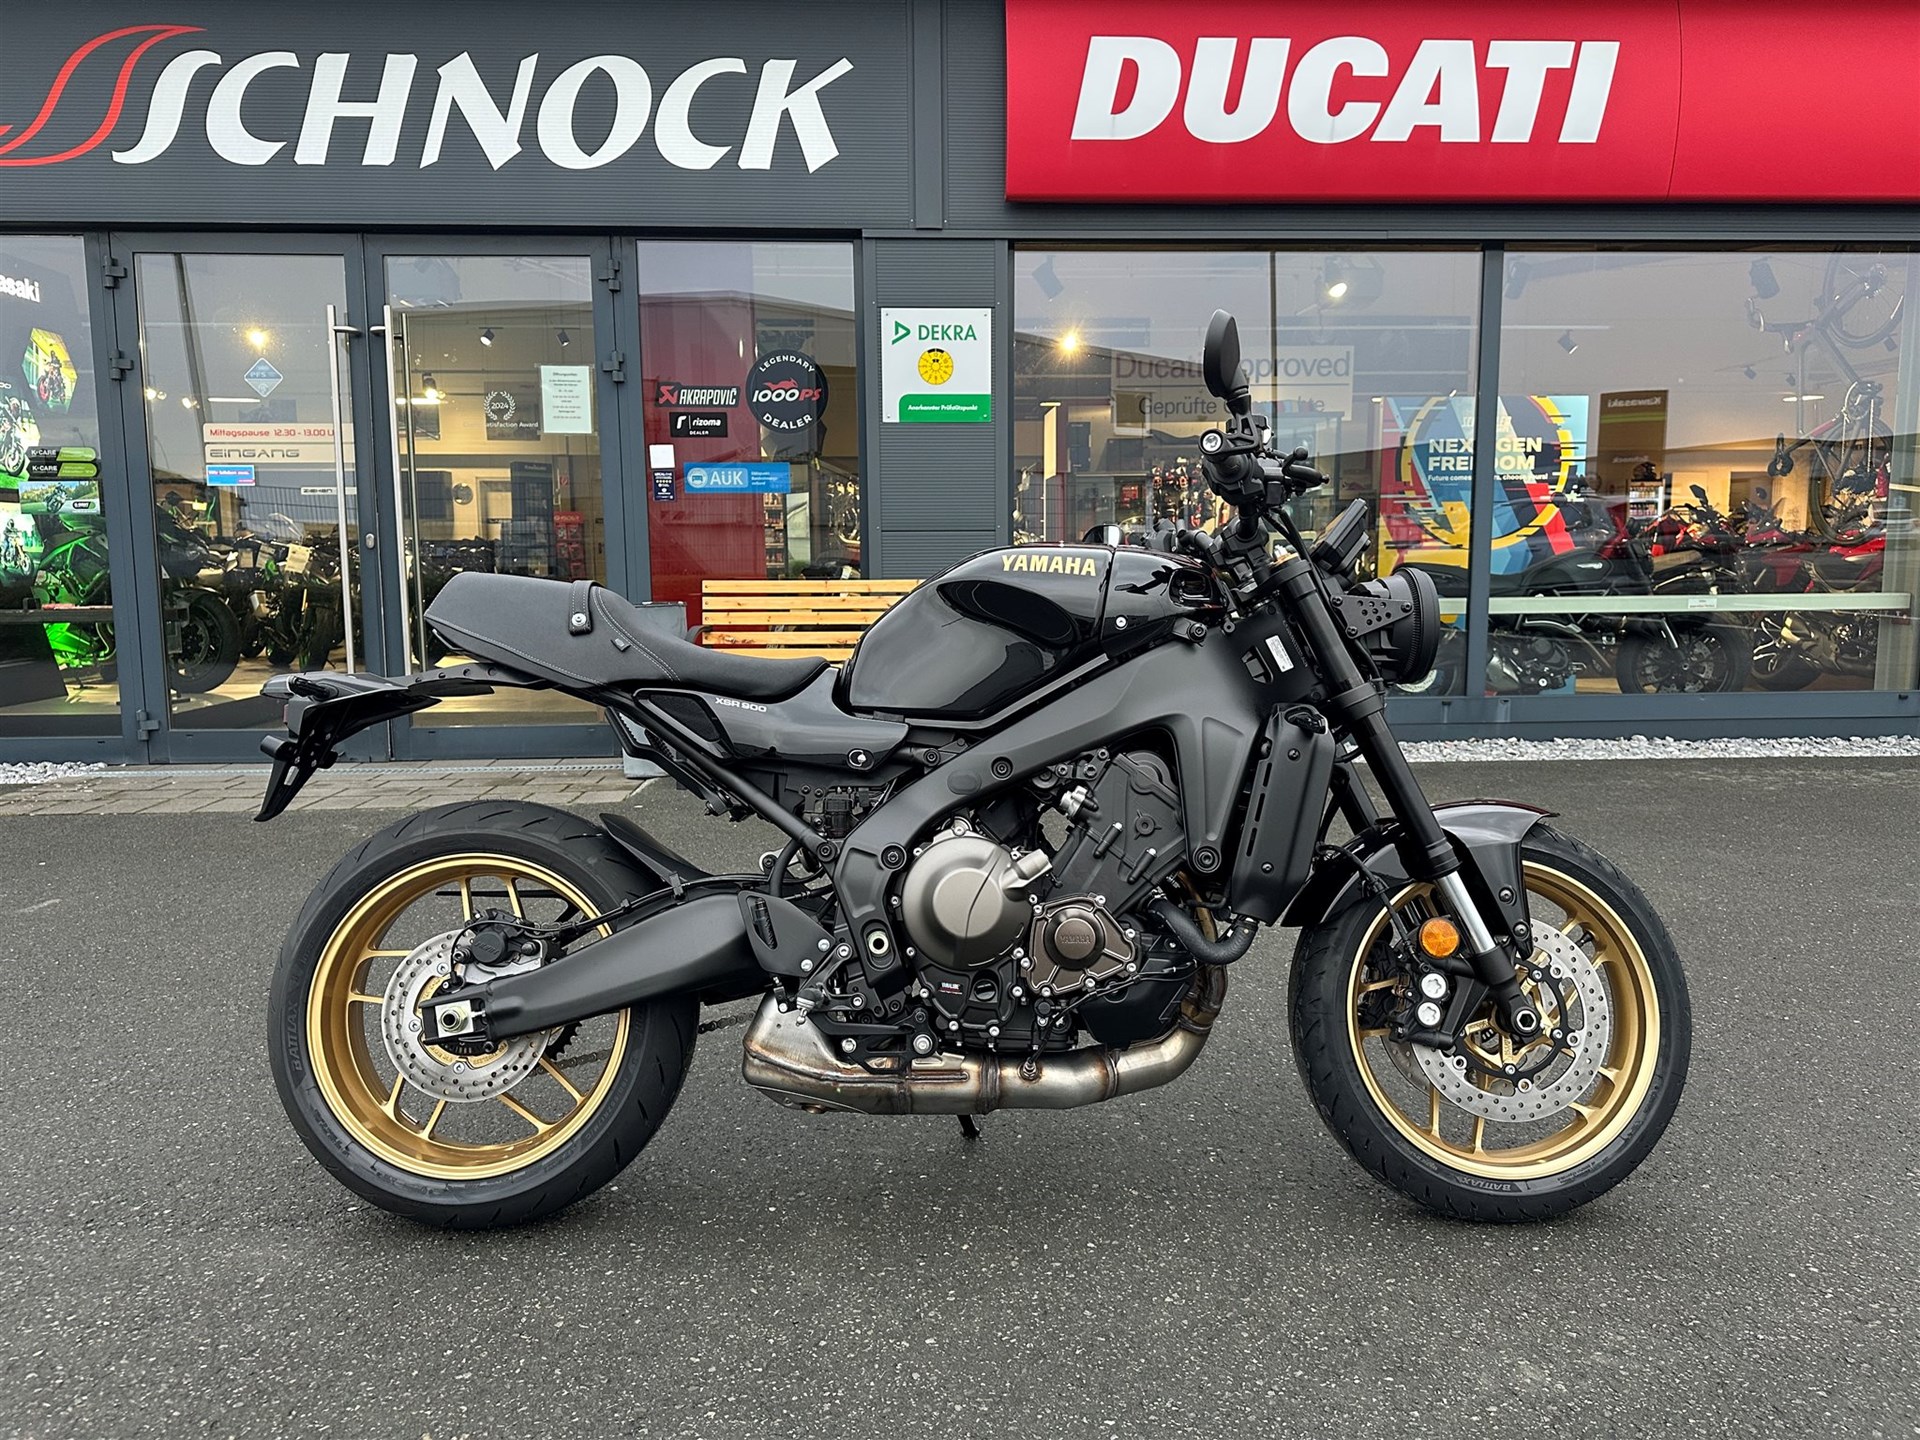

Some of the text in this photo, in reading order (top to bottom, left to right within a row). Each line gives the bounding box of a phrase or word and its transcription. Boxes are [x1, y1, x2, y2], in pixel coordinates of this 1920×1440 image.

[1070, 36, 1620, 144] DUCATI
[112, 50, 854, 174] SCHNOCK
[918, 324, 977, 341] DEKRA
[759, 355, 815, 373] LEGENDARY
[1116, 350, 1350, 383] Ducati pproved
[679, 387, 737, 406] AKRAPOVIČ
[752, 387, 822, 403] 1000PS
[491, 401, 509, 410] 2024
[1139, 396, 1217, 414] Geprüfte
[692, 417, 721, 427] rizoma
[762, 412, 813, 430] DEALER
[210, 428, 270, 438] Mittagspause
[274, 428, 296, 436] 12.30
[304, 428, 325, 436] 13.00
[1429, 437, 1542, 453] NEX GEN
[1428, 455, 1536, 471] FREOM
[1002, 554, 1097, 577] YAMAHA
[715, 697, 767, 713] XSR 900
[288, 1001, 303, 1072] BATTLAX
[1460, 1176, 1511, 1192] BATTLAX
